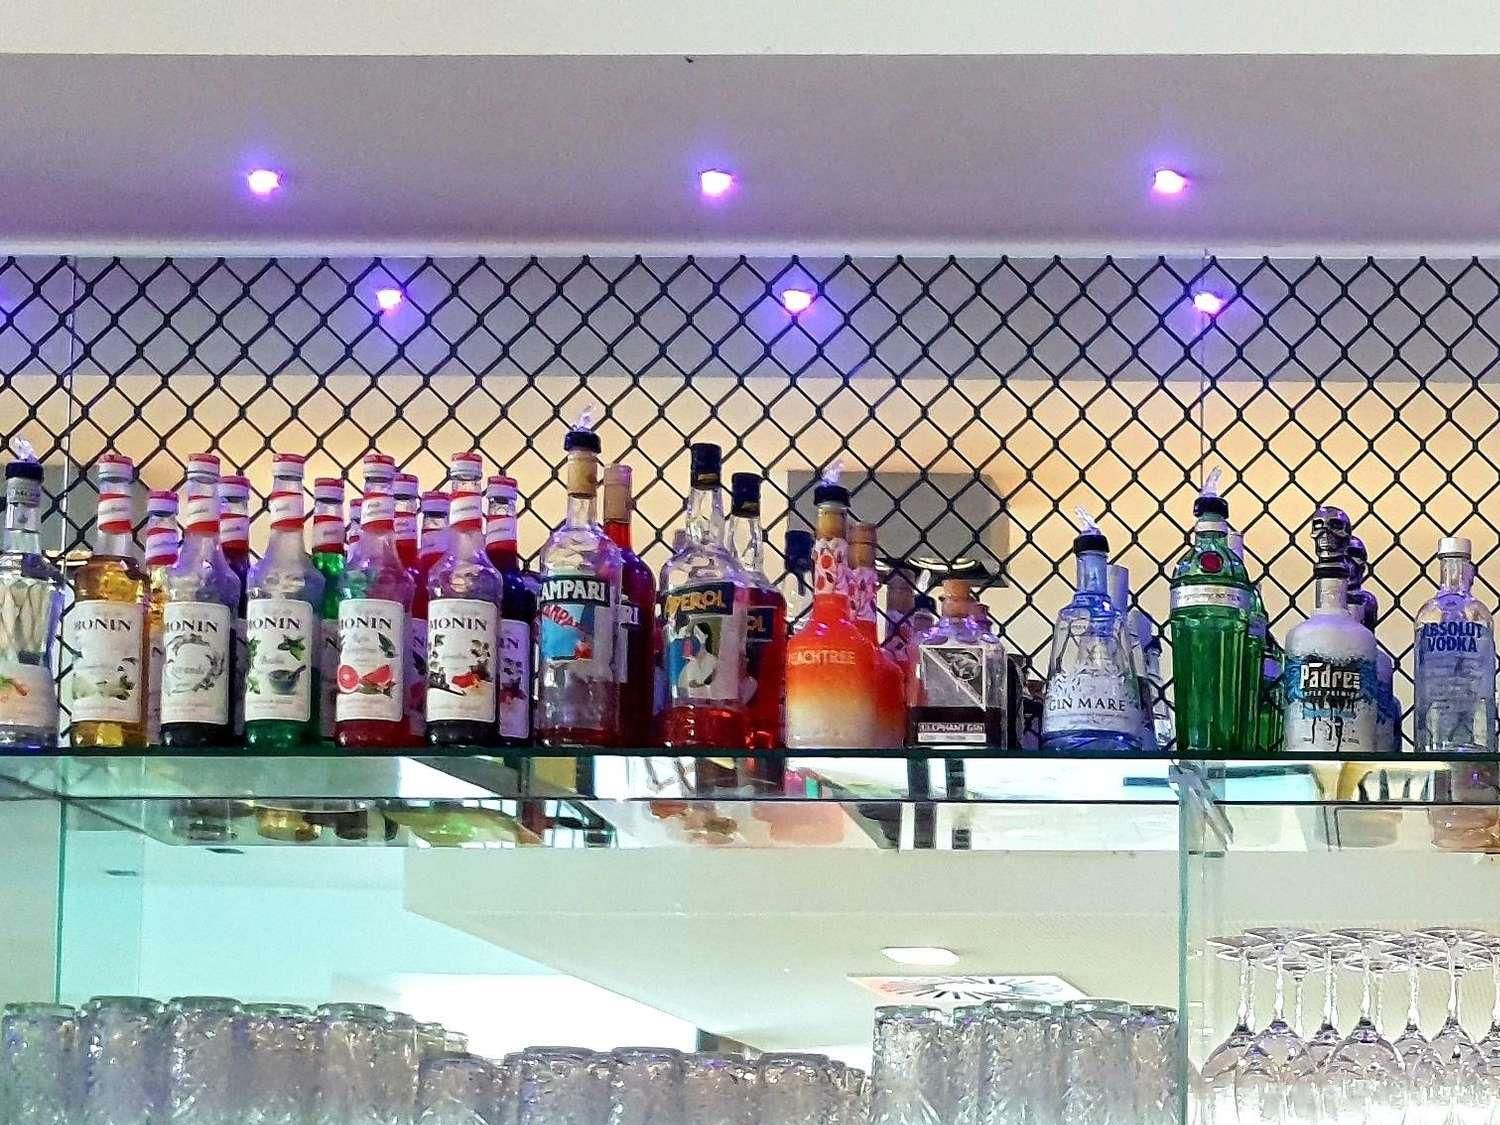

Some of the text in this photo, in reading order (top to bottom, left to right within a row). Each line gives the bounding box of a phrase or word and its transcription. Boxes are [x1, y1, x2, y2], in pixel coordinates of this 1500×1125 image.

[541, 579, 605, 602] AMPARI
[249, 617, 301, 630] ONIN
[429, 616, 488, 631] MONIN
[1423, 621, 1482, 638] ABSOLUT
[1427, 636, 1478, 652] VODKA
[1049, 698, 1126, 712] GIN MARE
